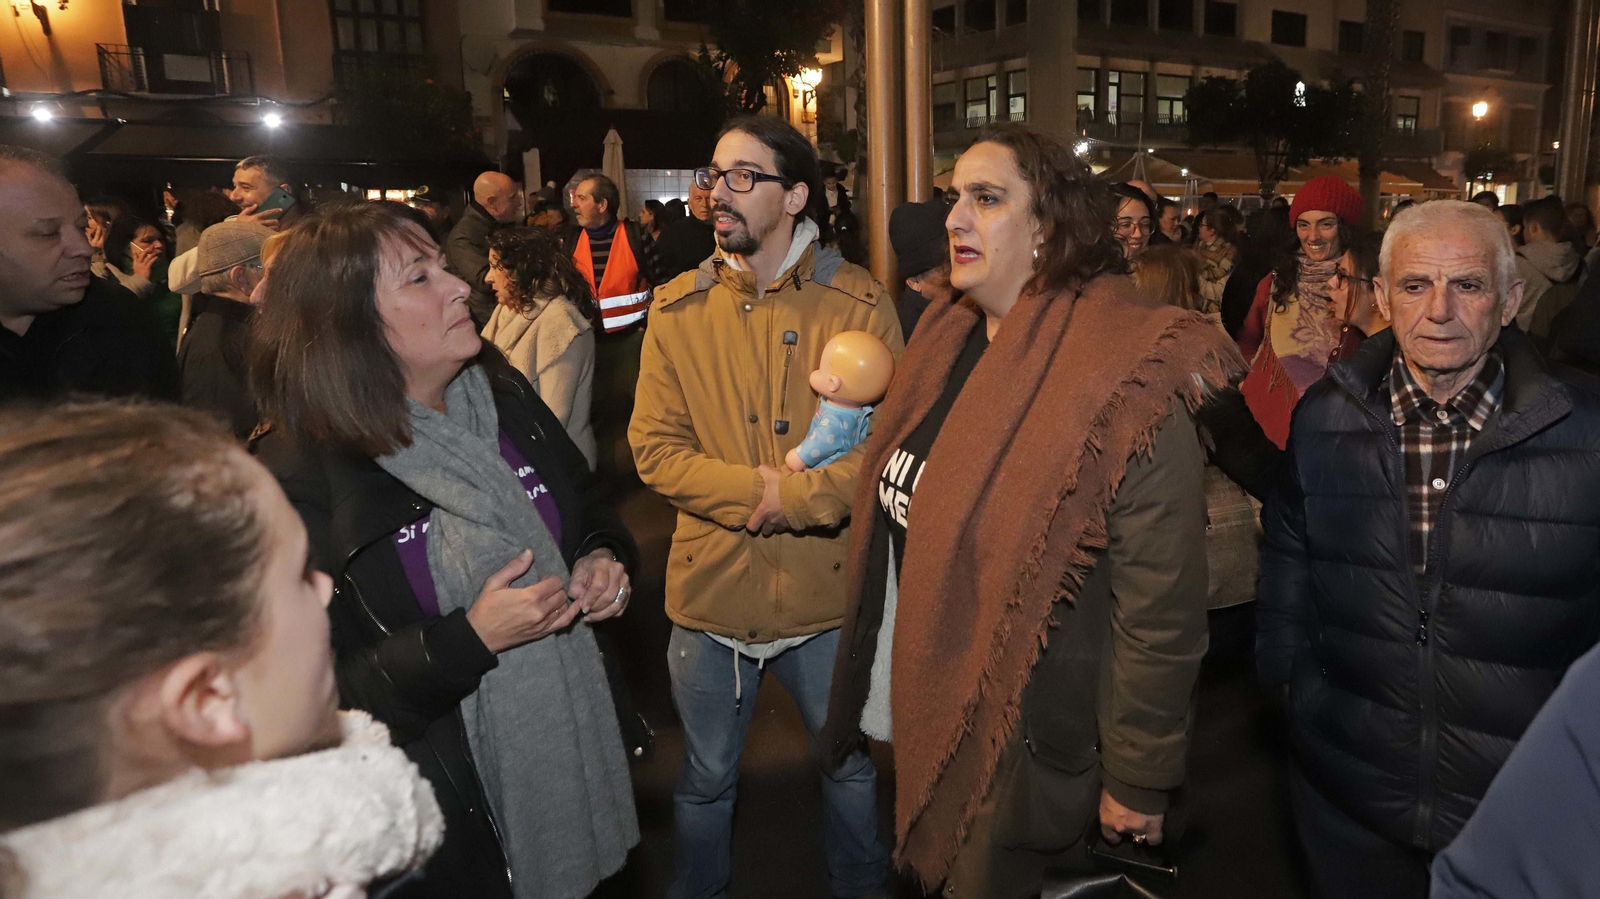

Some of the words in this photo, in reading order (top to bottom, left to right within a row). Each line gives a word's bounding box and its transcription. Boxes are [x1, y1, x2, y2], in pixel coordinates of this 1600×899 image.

[882, 449, 915, 488] NI
[879, 481, 913, 529] ME
[397, 525, 416, 543] Si
